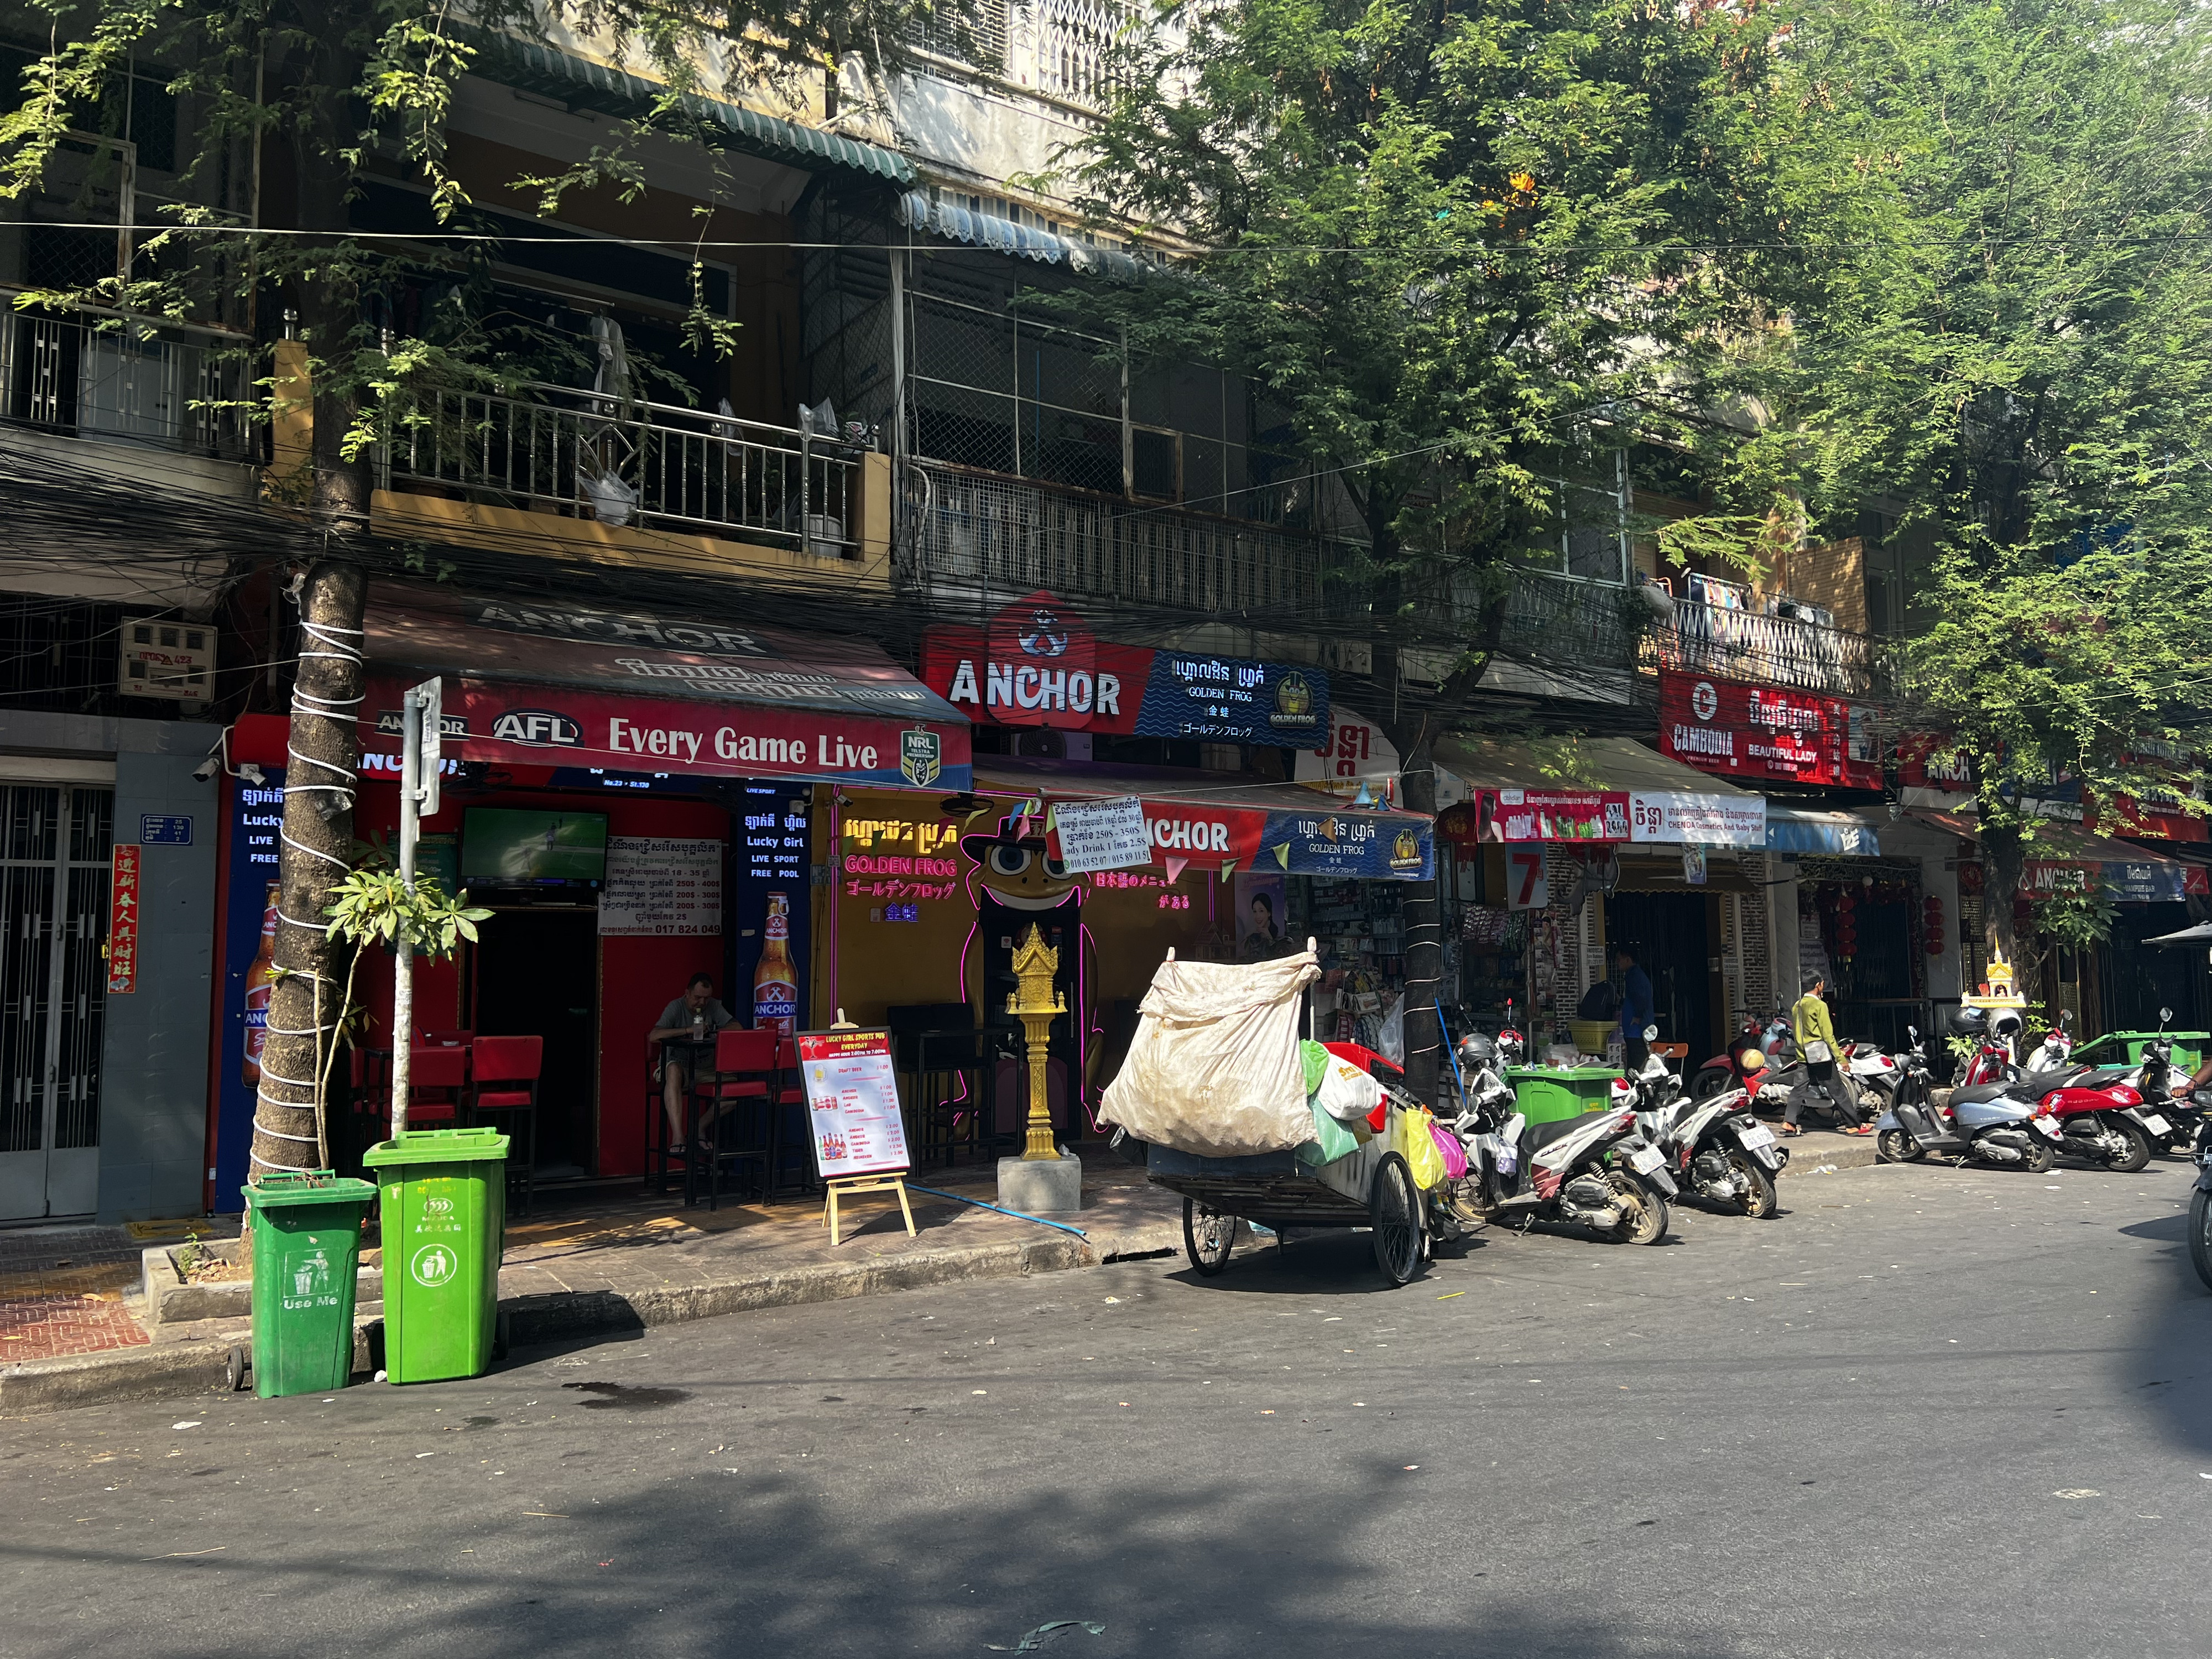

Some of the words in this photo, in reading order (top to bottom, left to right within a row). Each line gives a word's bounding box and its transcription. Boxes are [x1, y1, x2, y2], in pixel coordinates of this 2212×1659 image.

[478, 607, 766, 653] ANCHOR
[950, 659, 1120, 716] ANCHOR
[1189, 687, 1224, 699] GOLDEN
[1229, 690, 1252, 702] FROG
[1208, 705, 1229, 717] 金蛙
[1270, 714, 1297, 723] GOLDEN
[1297, 714, 1316, 724] FROG
[379, 715, 465, 734] ANOR
[494, 714, 575, 743] AFL
[1183, 722, 1253, 737] ゴールデンフロッグ
[609, 717, 703, 764] Every
[715, 727, 806, 764] Game
[818, 735, 878, 769] Live
[908, 736, 934, 749] NRL
[1674, 724, 1733, 756] CAMBODIA
[1749, 744, 1794, 760] BEAUTIFUL
[1796, 750, 1817, 763] LADY
[1096, 830, 1113, 839] 250$
[1120, 826, 1140, 837] 350$
[1668, 821, 1695, 829] CHENDA
[1736, 824, 1749, 833] Baby
[249, 836, 273, 844] LIVE
[747, 836, 778, 848] Lucky
[784, 837, 804, 847] Girl
[1062, 846, 1080, 856] Lady
[1082, 843, 1105, 853] Drink
[1129, 837, 1146, 847] 2.5$
[1309, 844, 1340, 854] GOLDEN
[1343, 846, 1364, 855] FROG
[251, 854, 278, 863] FREE
[845, 854, 912, 874] GOLDEN
[915, 858, 957, 877] FROG
[1071, 859, 1081, 868] 010
[1083, 858, 1089, 867] 63
[1091, 857, 1098, 865] 52
[1099, 856, 1106, 864] 07
[1112, 854, 1123, 863] 015
[1125, 853, 1133, 861] 89
[1135, 851, 1141, 860] 11
[1096, 871, 1177, 888] 日本語のメニュー
[1511, 853, 1541, 904] 7
[846, 879, 956, 899] ゴールデンフロッグ
[885, 902, 919, 922] 金蛙
[656, 925, 674, 933] 017
[679, 925, 698, 933] 824
[701, 925, 721, 933] 049
[754, 1004, 796, 1015] ANCHOR
[284, 1300, 312, 1309] Use
[316, 1296, 338, 1306] Me
